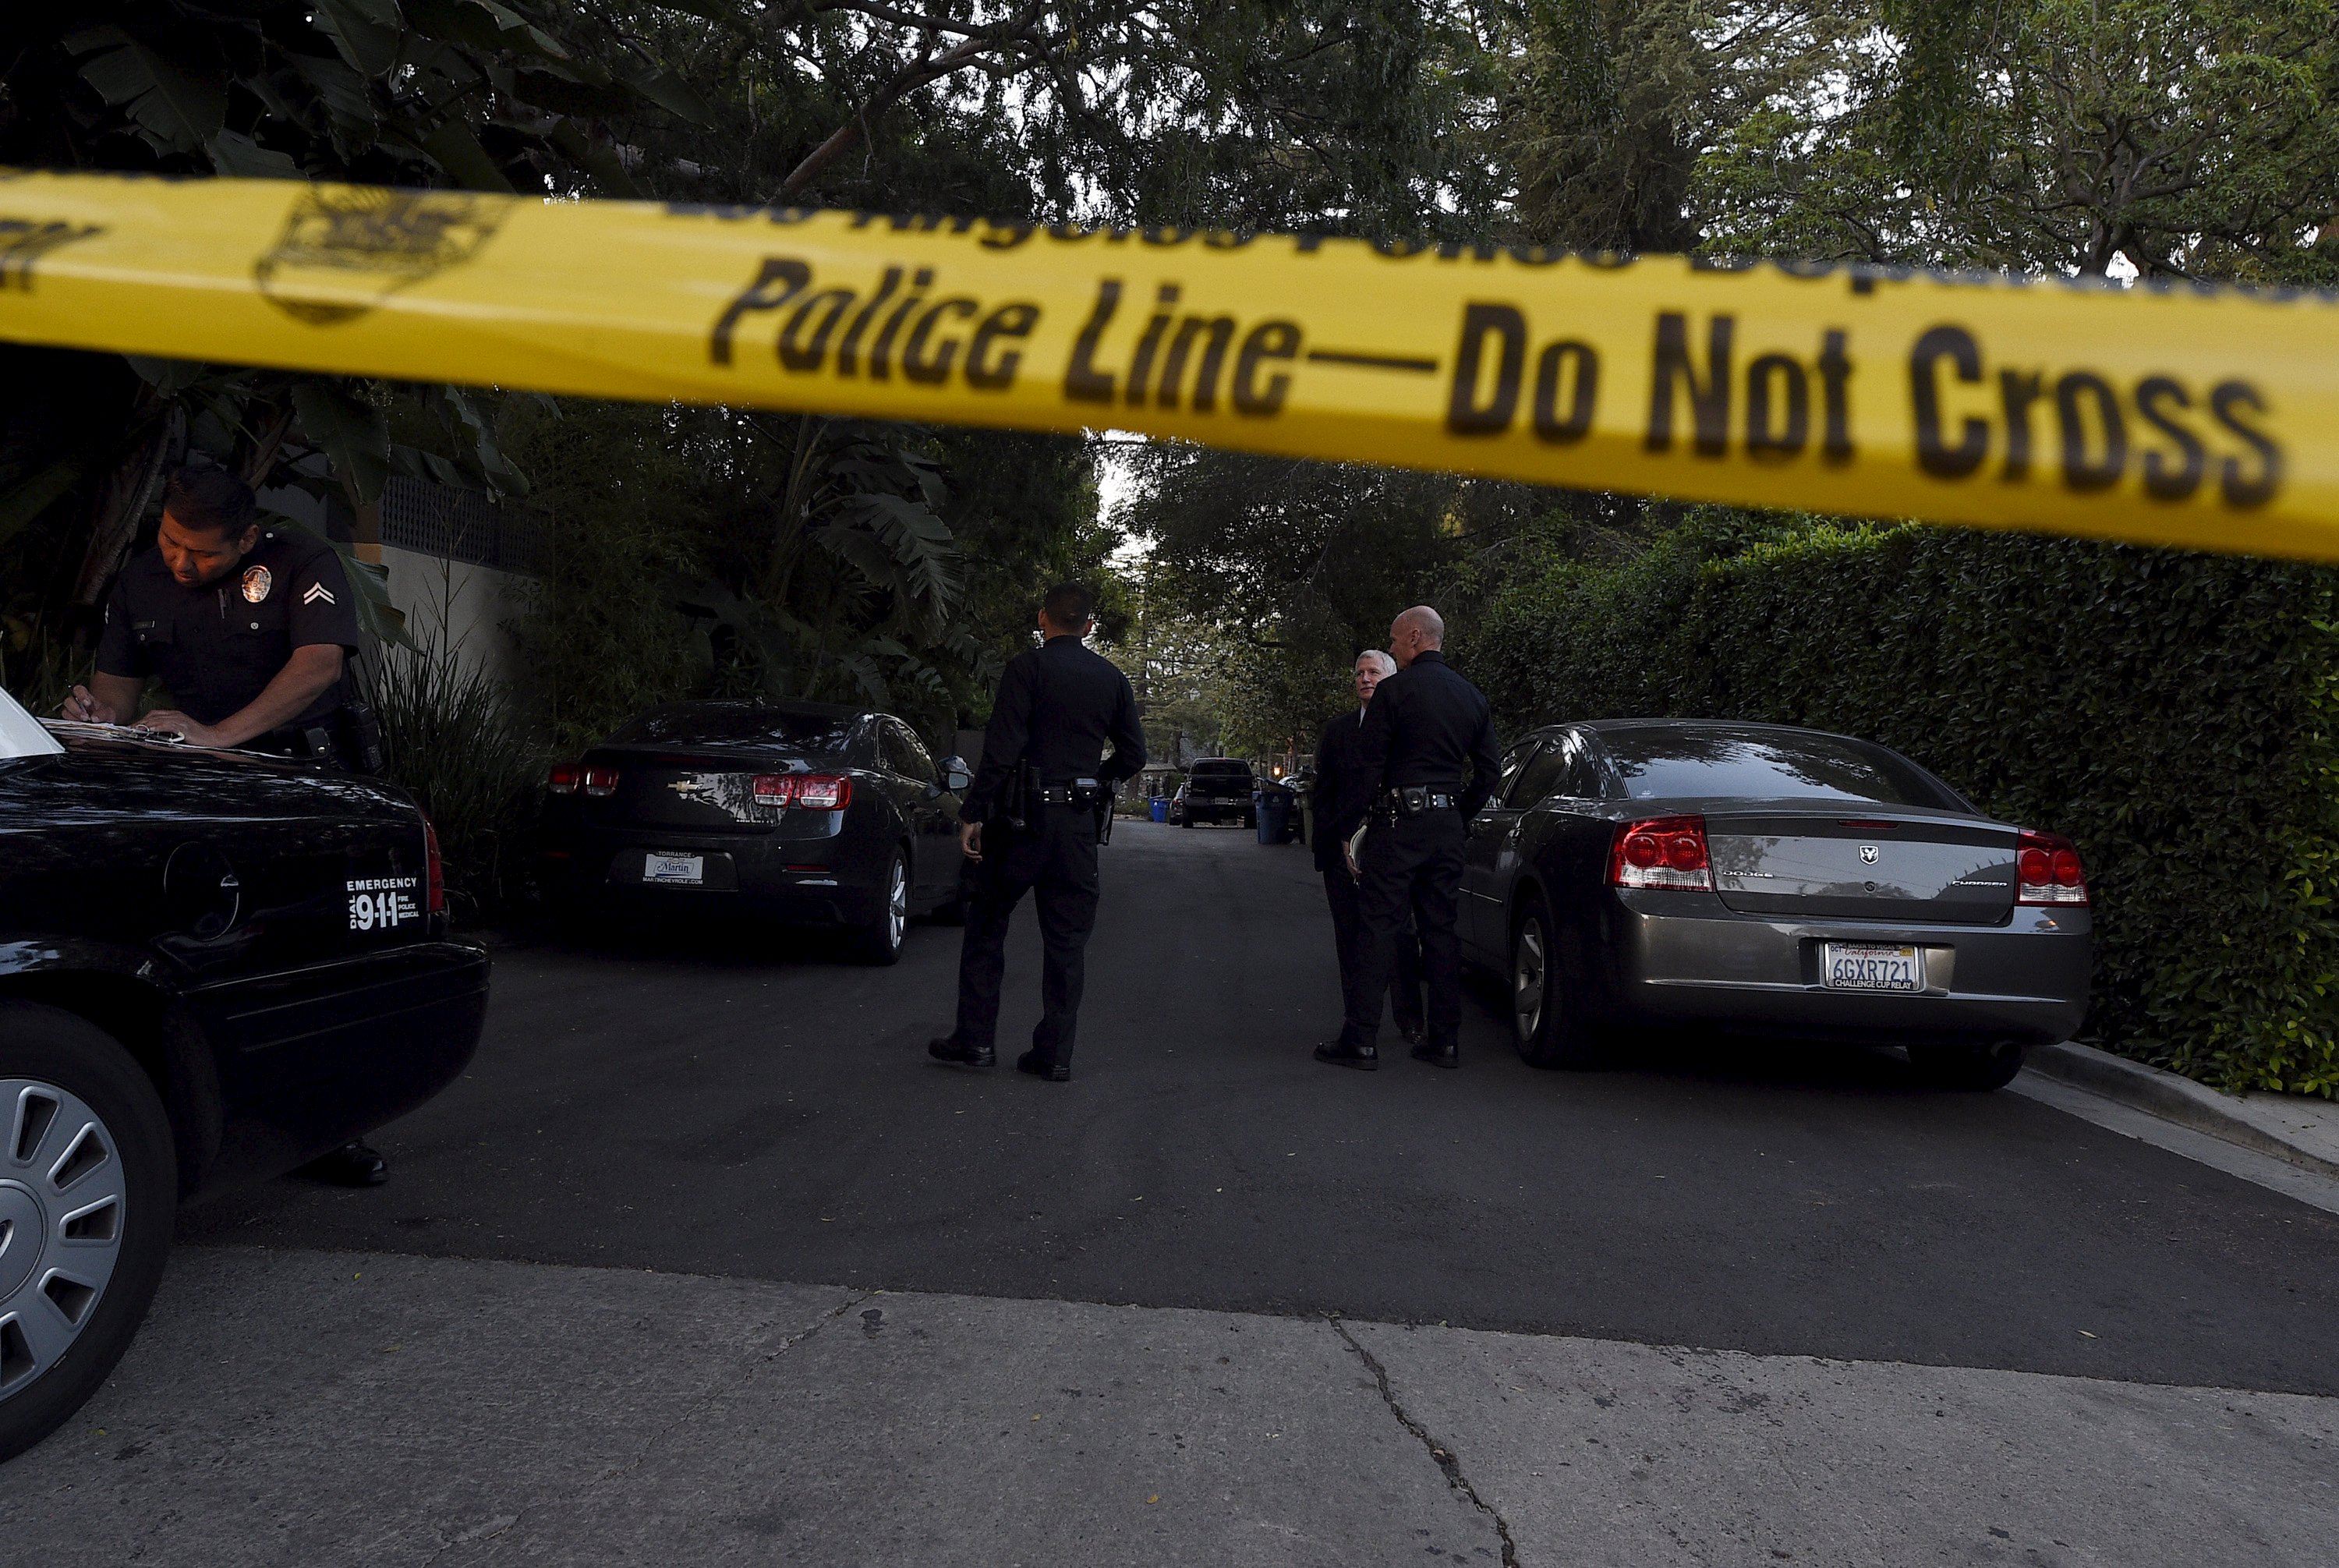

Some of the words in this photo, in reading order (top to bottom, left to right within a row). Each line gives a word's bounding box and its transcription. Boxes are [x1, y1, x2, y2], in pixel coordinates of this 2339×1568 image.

[711, 258, 1041, 390] Police
[1646, 311, 1852, 469] Not
[1911, 324, 2281, 508] Cross
[657, 863, 689, 873] Martin
[347, 878, 417, 891] EMERGENCY
[1845, 948, 1895, 958] California
[1834, 958, 1912, 982] 6GXR721
[1835, 979, 1875, 988] CHALLENGE
[1876, 980, 1891, 989] CUP
[1891, 981, 1912, 989] RELAY
